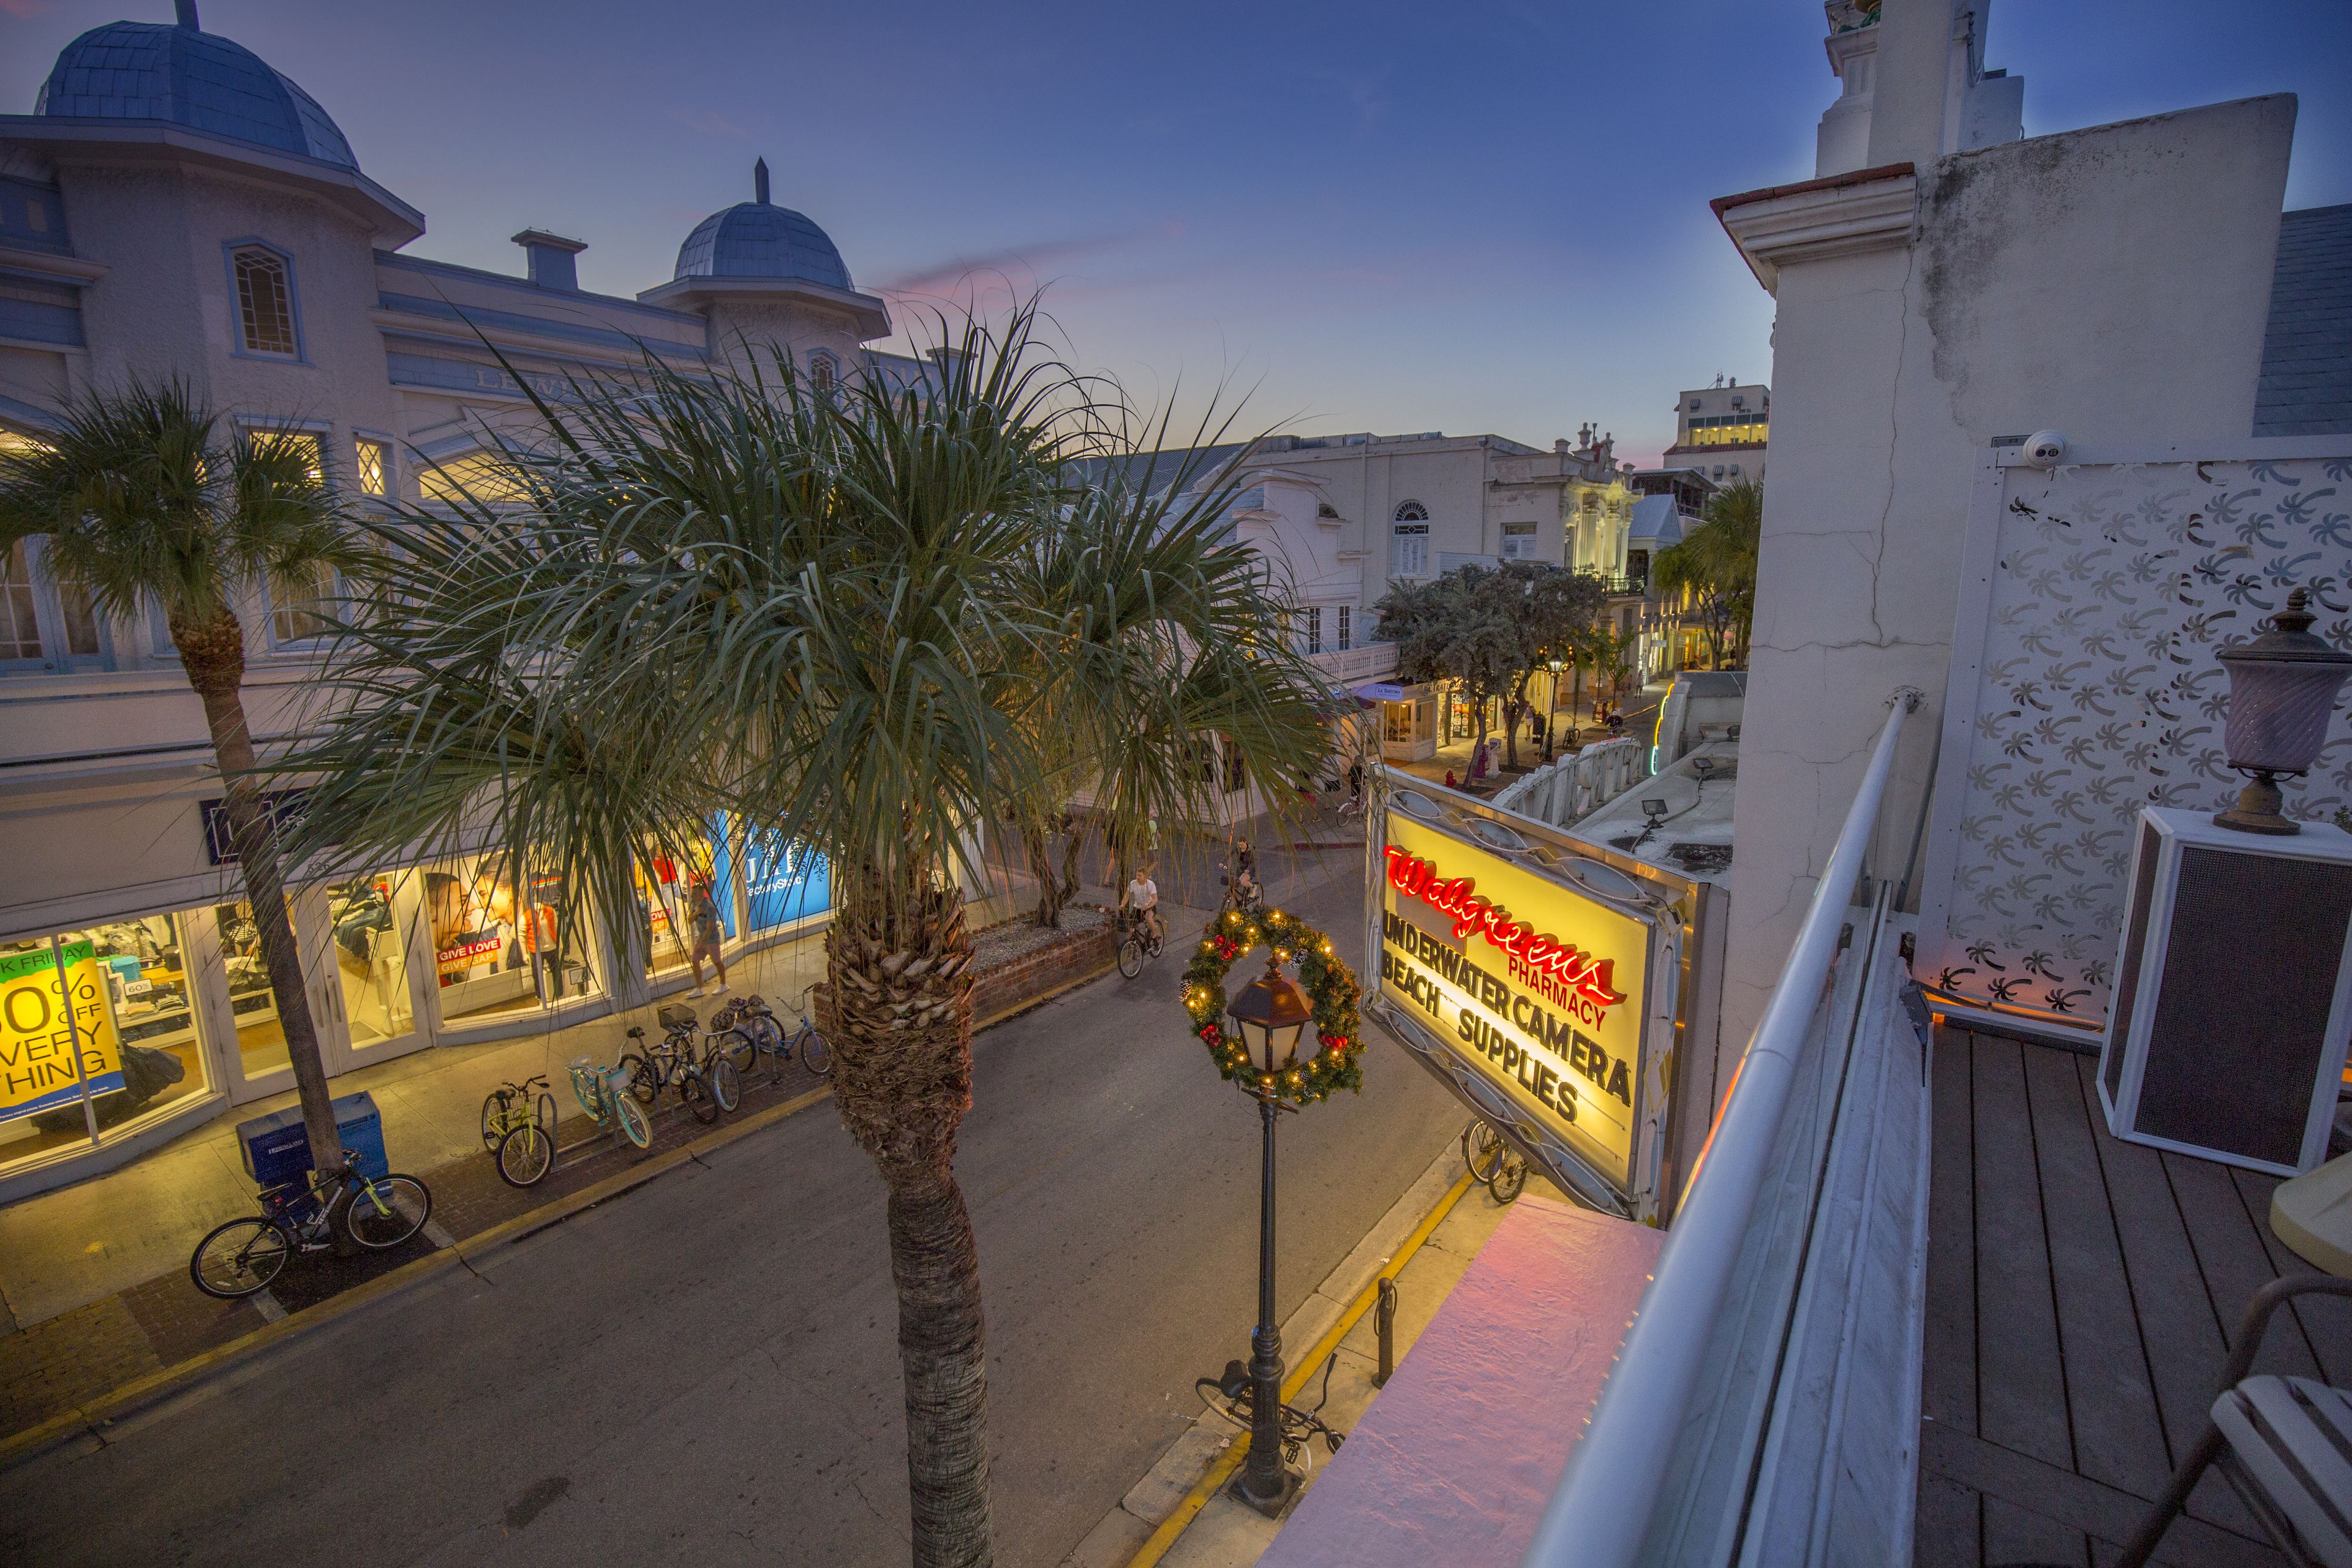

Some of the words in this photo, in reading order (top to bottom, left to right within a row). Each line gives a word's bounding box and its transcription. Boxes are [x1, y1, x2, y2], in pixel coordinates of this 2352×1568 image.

[653, 921, 665, 930] AP
[1384, 845, 1627, 1006] Walgreens
[20, 946, 86, 969] FRIDAY
[440, 948, 467, 961] GIVE
[469, 940, 498, 954] LOVE
[441, 959, 467, 972] GIVE
[471, 953, 493, 965] GAP
[1383, 909, 1511, 1021] UNDERWATER
[1513, 995, 1632, 1107] CAMERA
[1509, 956, 1607, 1032] PHARMACY
[1382, 949, 1441, 1018] BEACH
[1458, 1008, 1578, 1122] SUPPLIES
